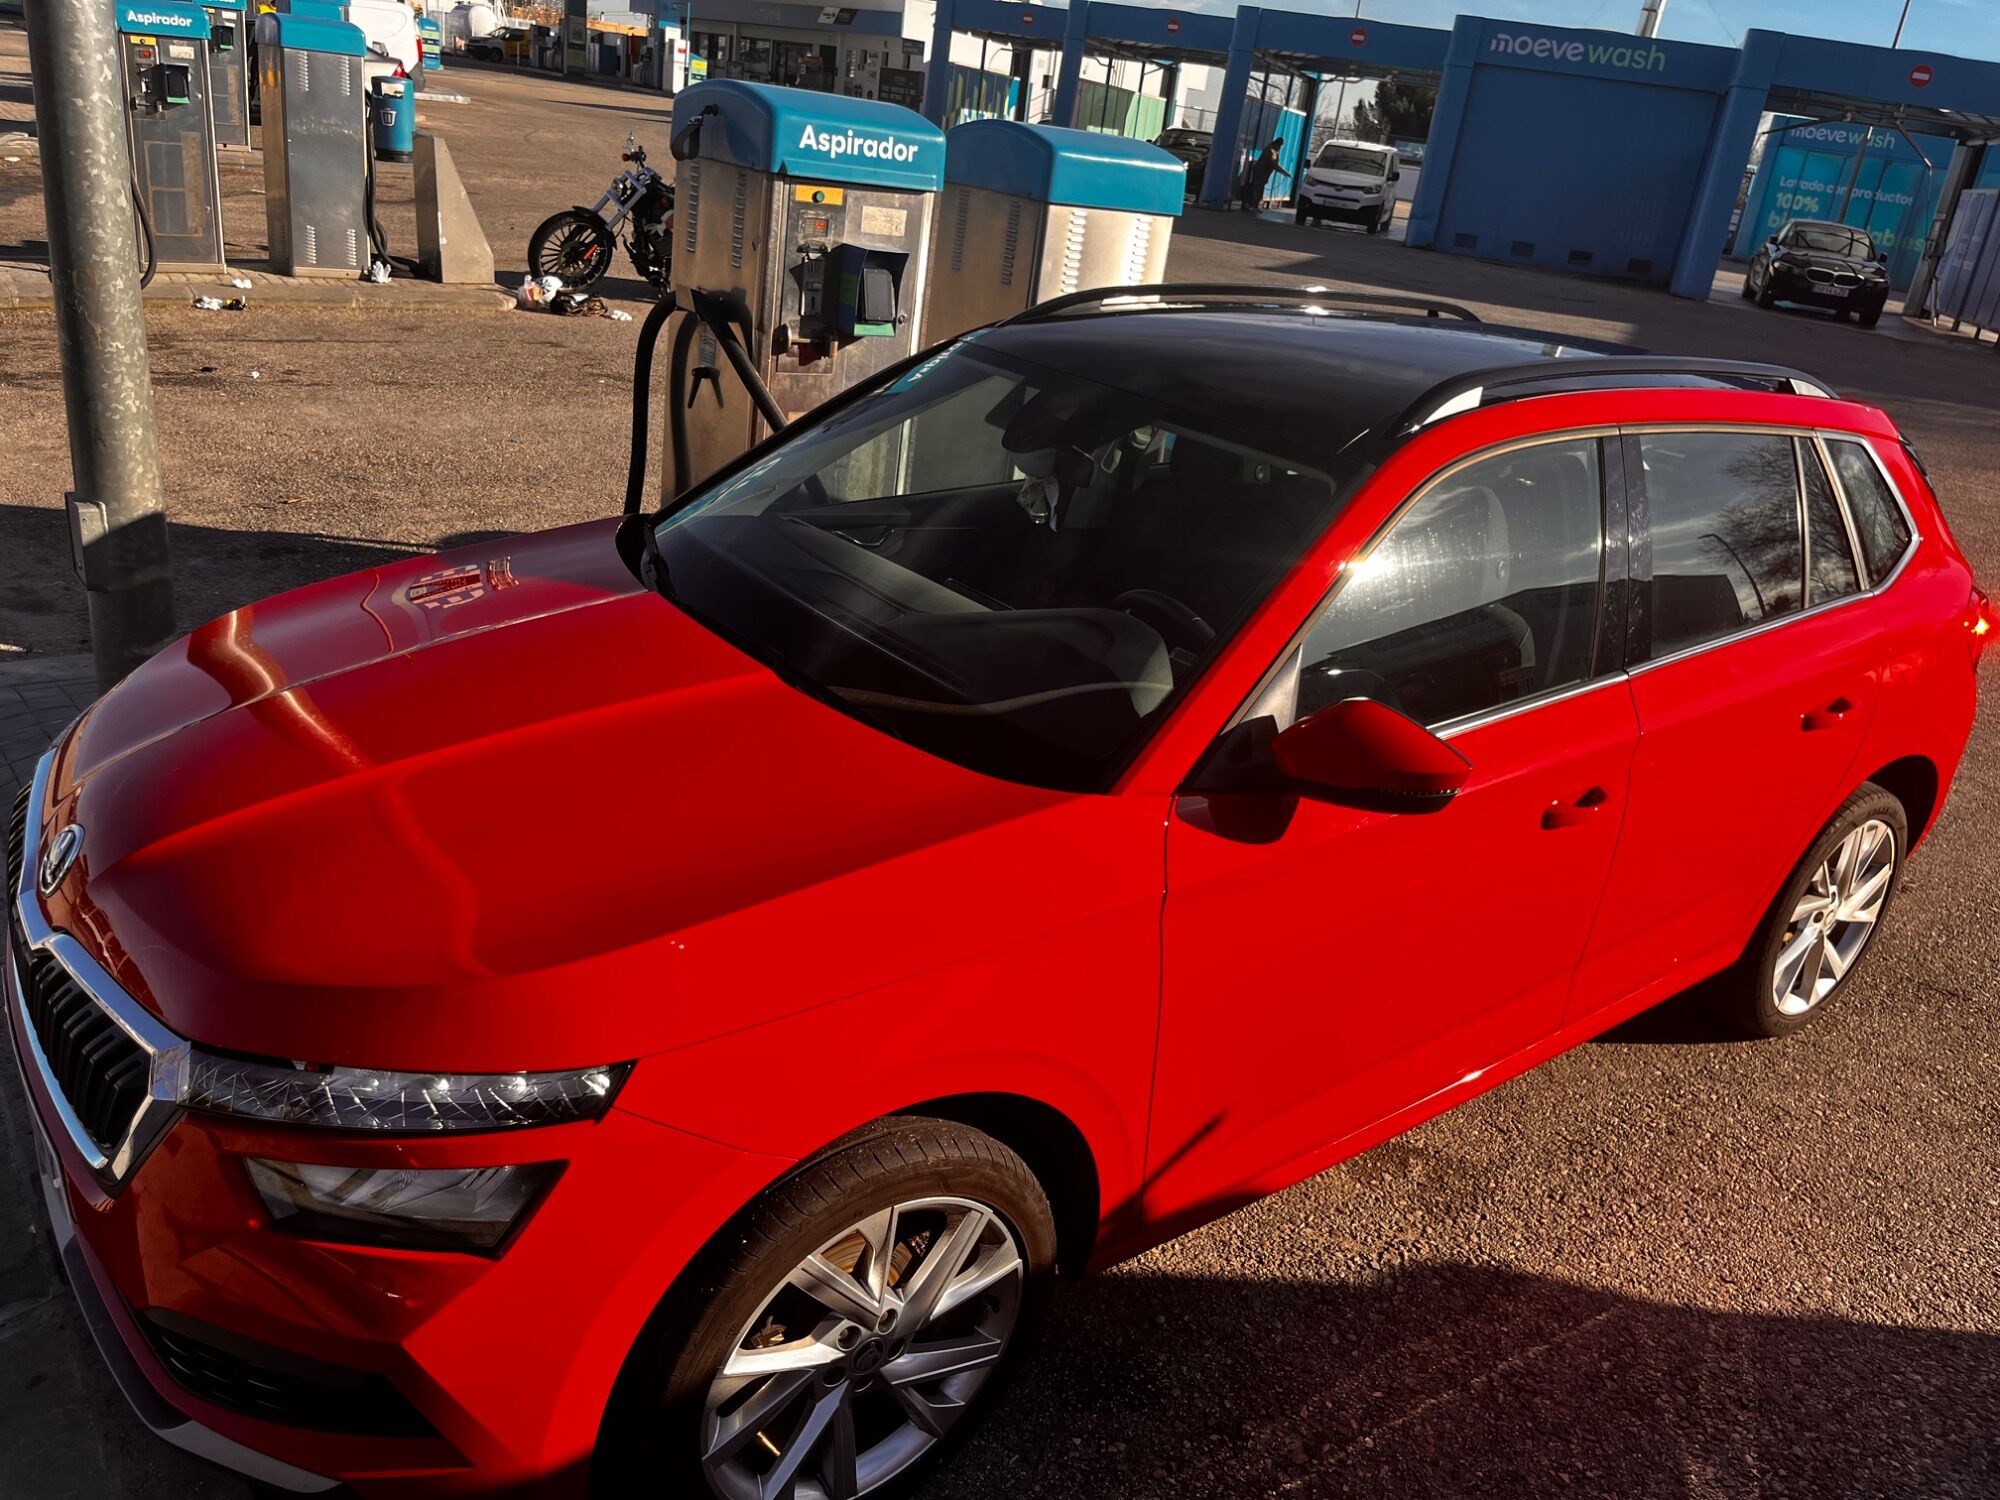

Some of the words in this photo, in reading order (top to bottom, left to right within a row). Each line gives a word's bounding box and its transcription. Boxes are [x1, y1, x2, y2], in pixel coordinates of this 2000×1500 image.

[127, 10, 193, 27] Aspirador
[1490, 33, 1585, 62] moeve
[1588, 45, 1666, 72] wash
[799, 124, 919, 162] Aspirador
[1790, 127, 1848, 143] moeve
[1776, 192, 1819, 213] 100%
